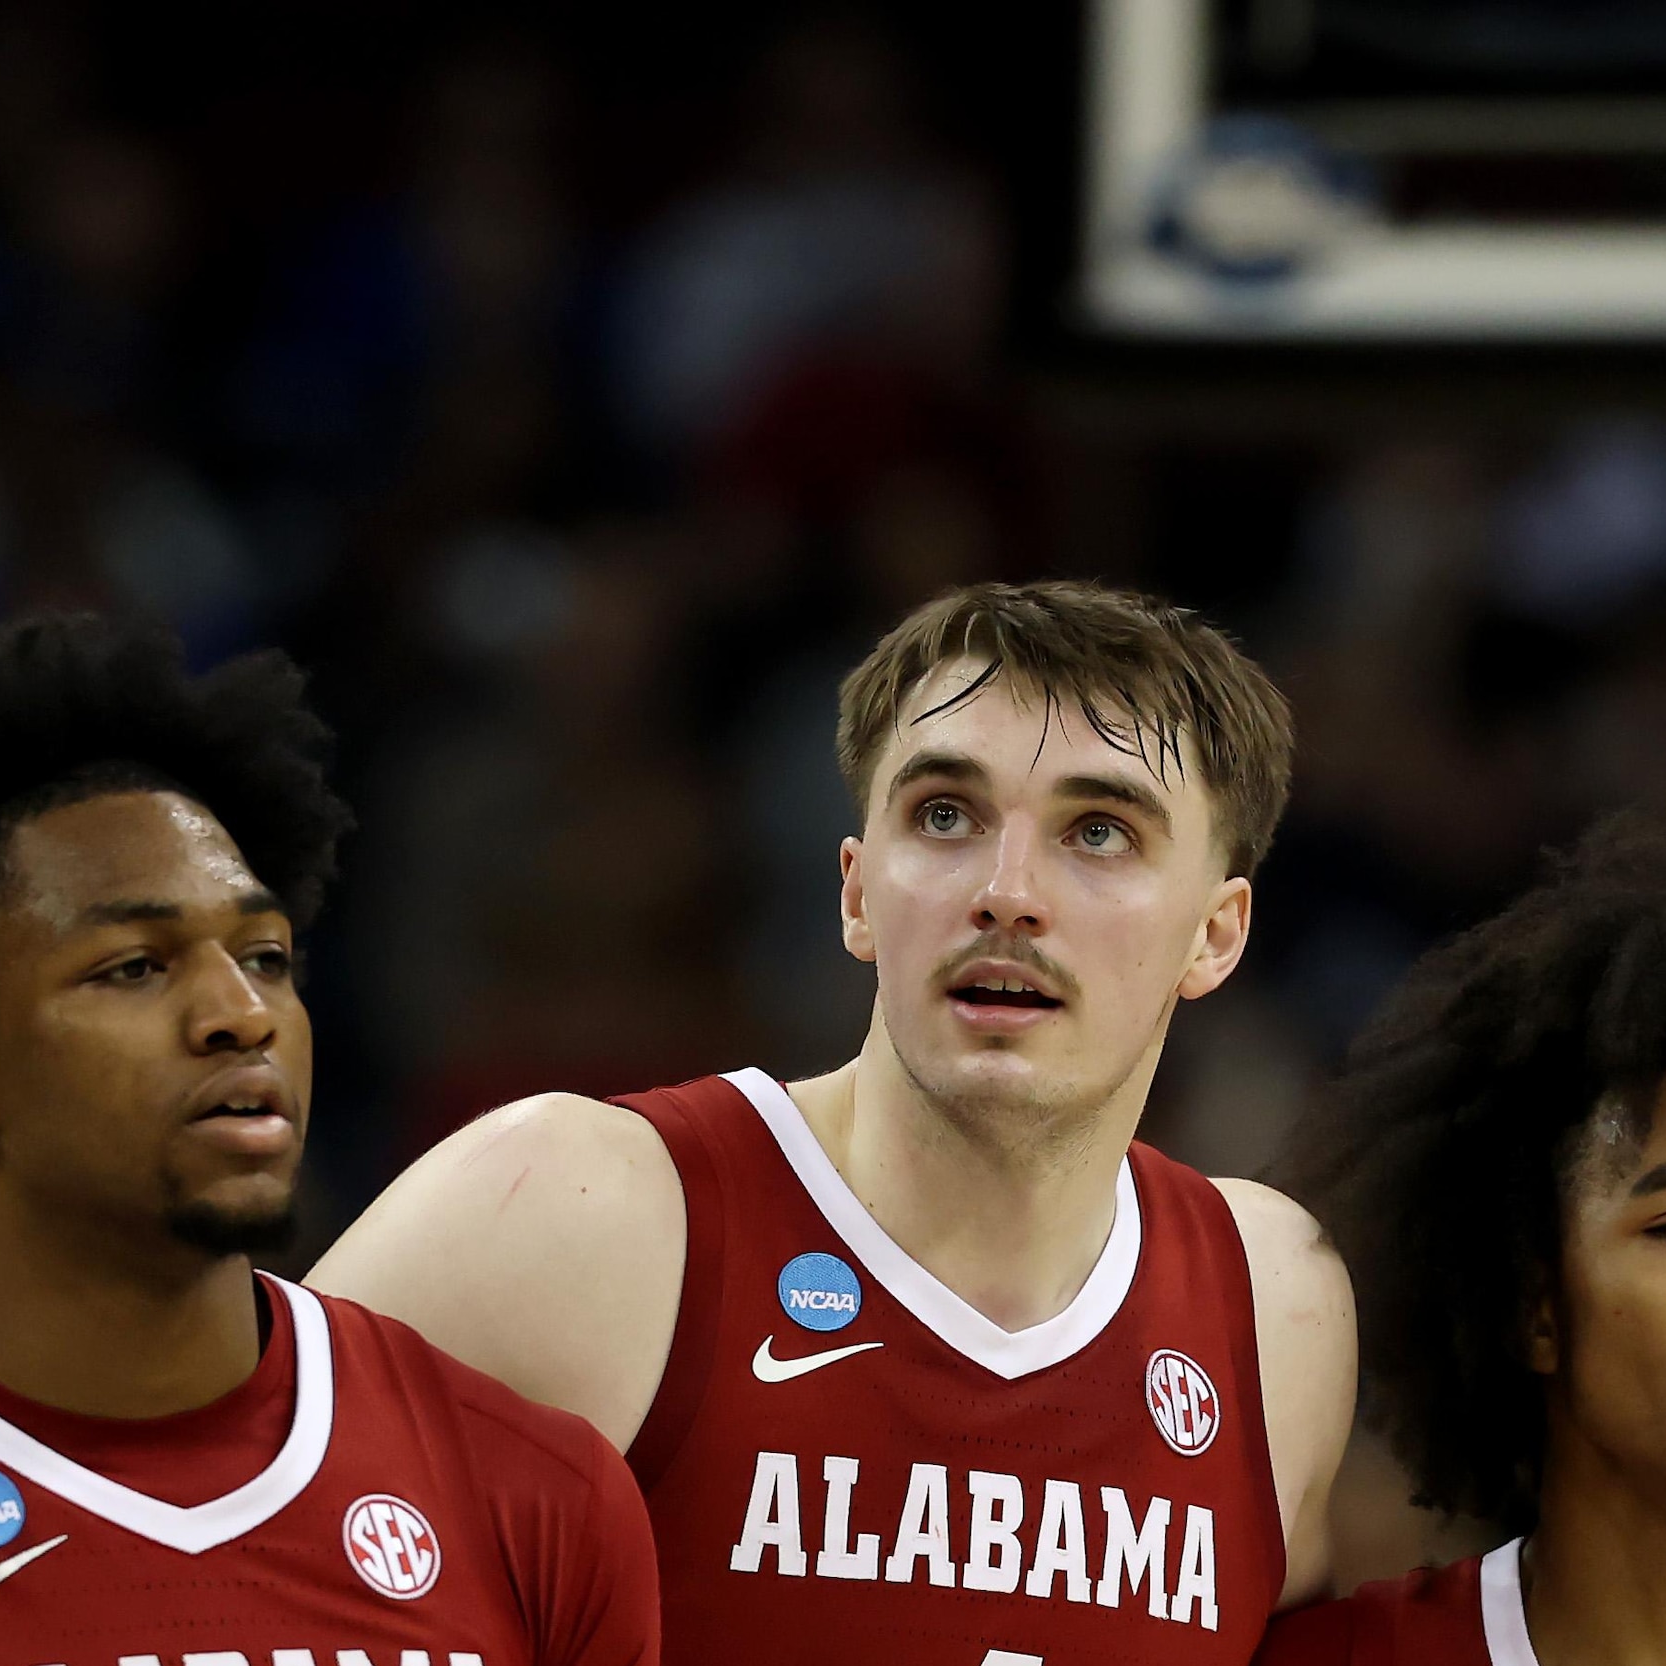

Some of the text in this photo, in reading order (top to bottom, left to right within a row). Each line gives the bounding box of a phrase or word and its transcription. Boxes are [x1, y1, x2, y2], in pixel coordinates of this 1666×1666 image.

[789, 1289, 855, 1312] NCAA
[1152, 1358, 1212, 1447] SEC
[351, 1503, 434, 1591] SEC
[730, 1451, 1218, 1632] ALABAMA
